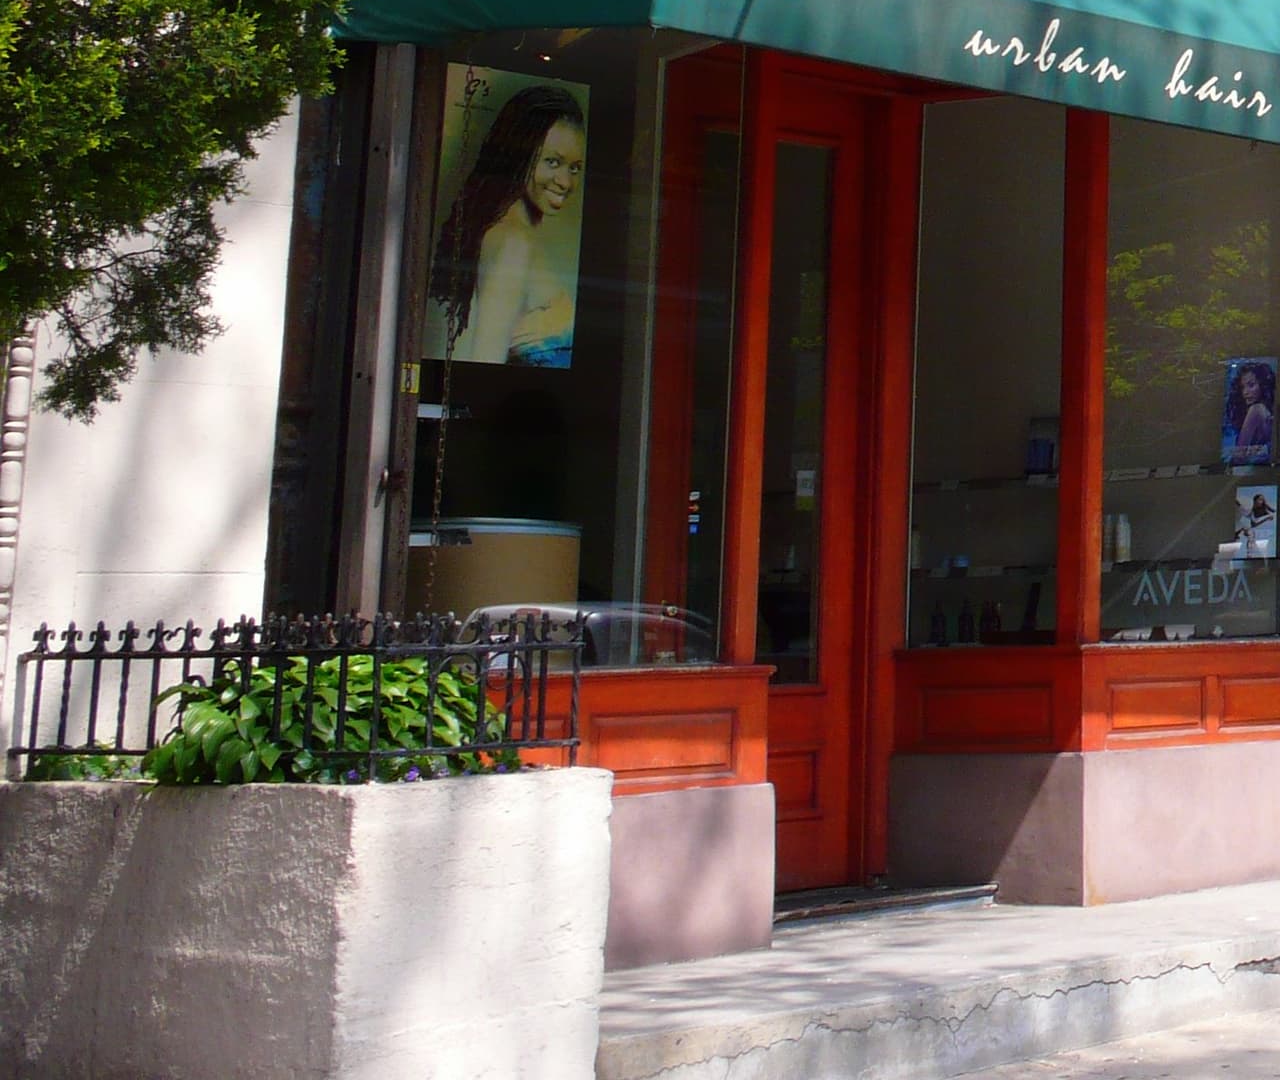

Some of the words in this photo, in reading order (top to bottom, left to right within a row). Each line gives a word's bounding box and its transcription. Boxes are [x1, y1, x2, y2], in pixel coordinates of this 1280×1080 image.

[964, 19, 1126, 84] urban
[1165, 48, 1272, 118] hair
[1132, 568, 1253, 606] AVEDA
